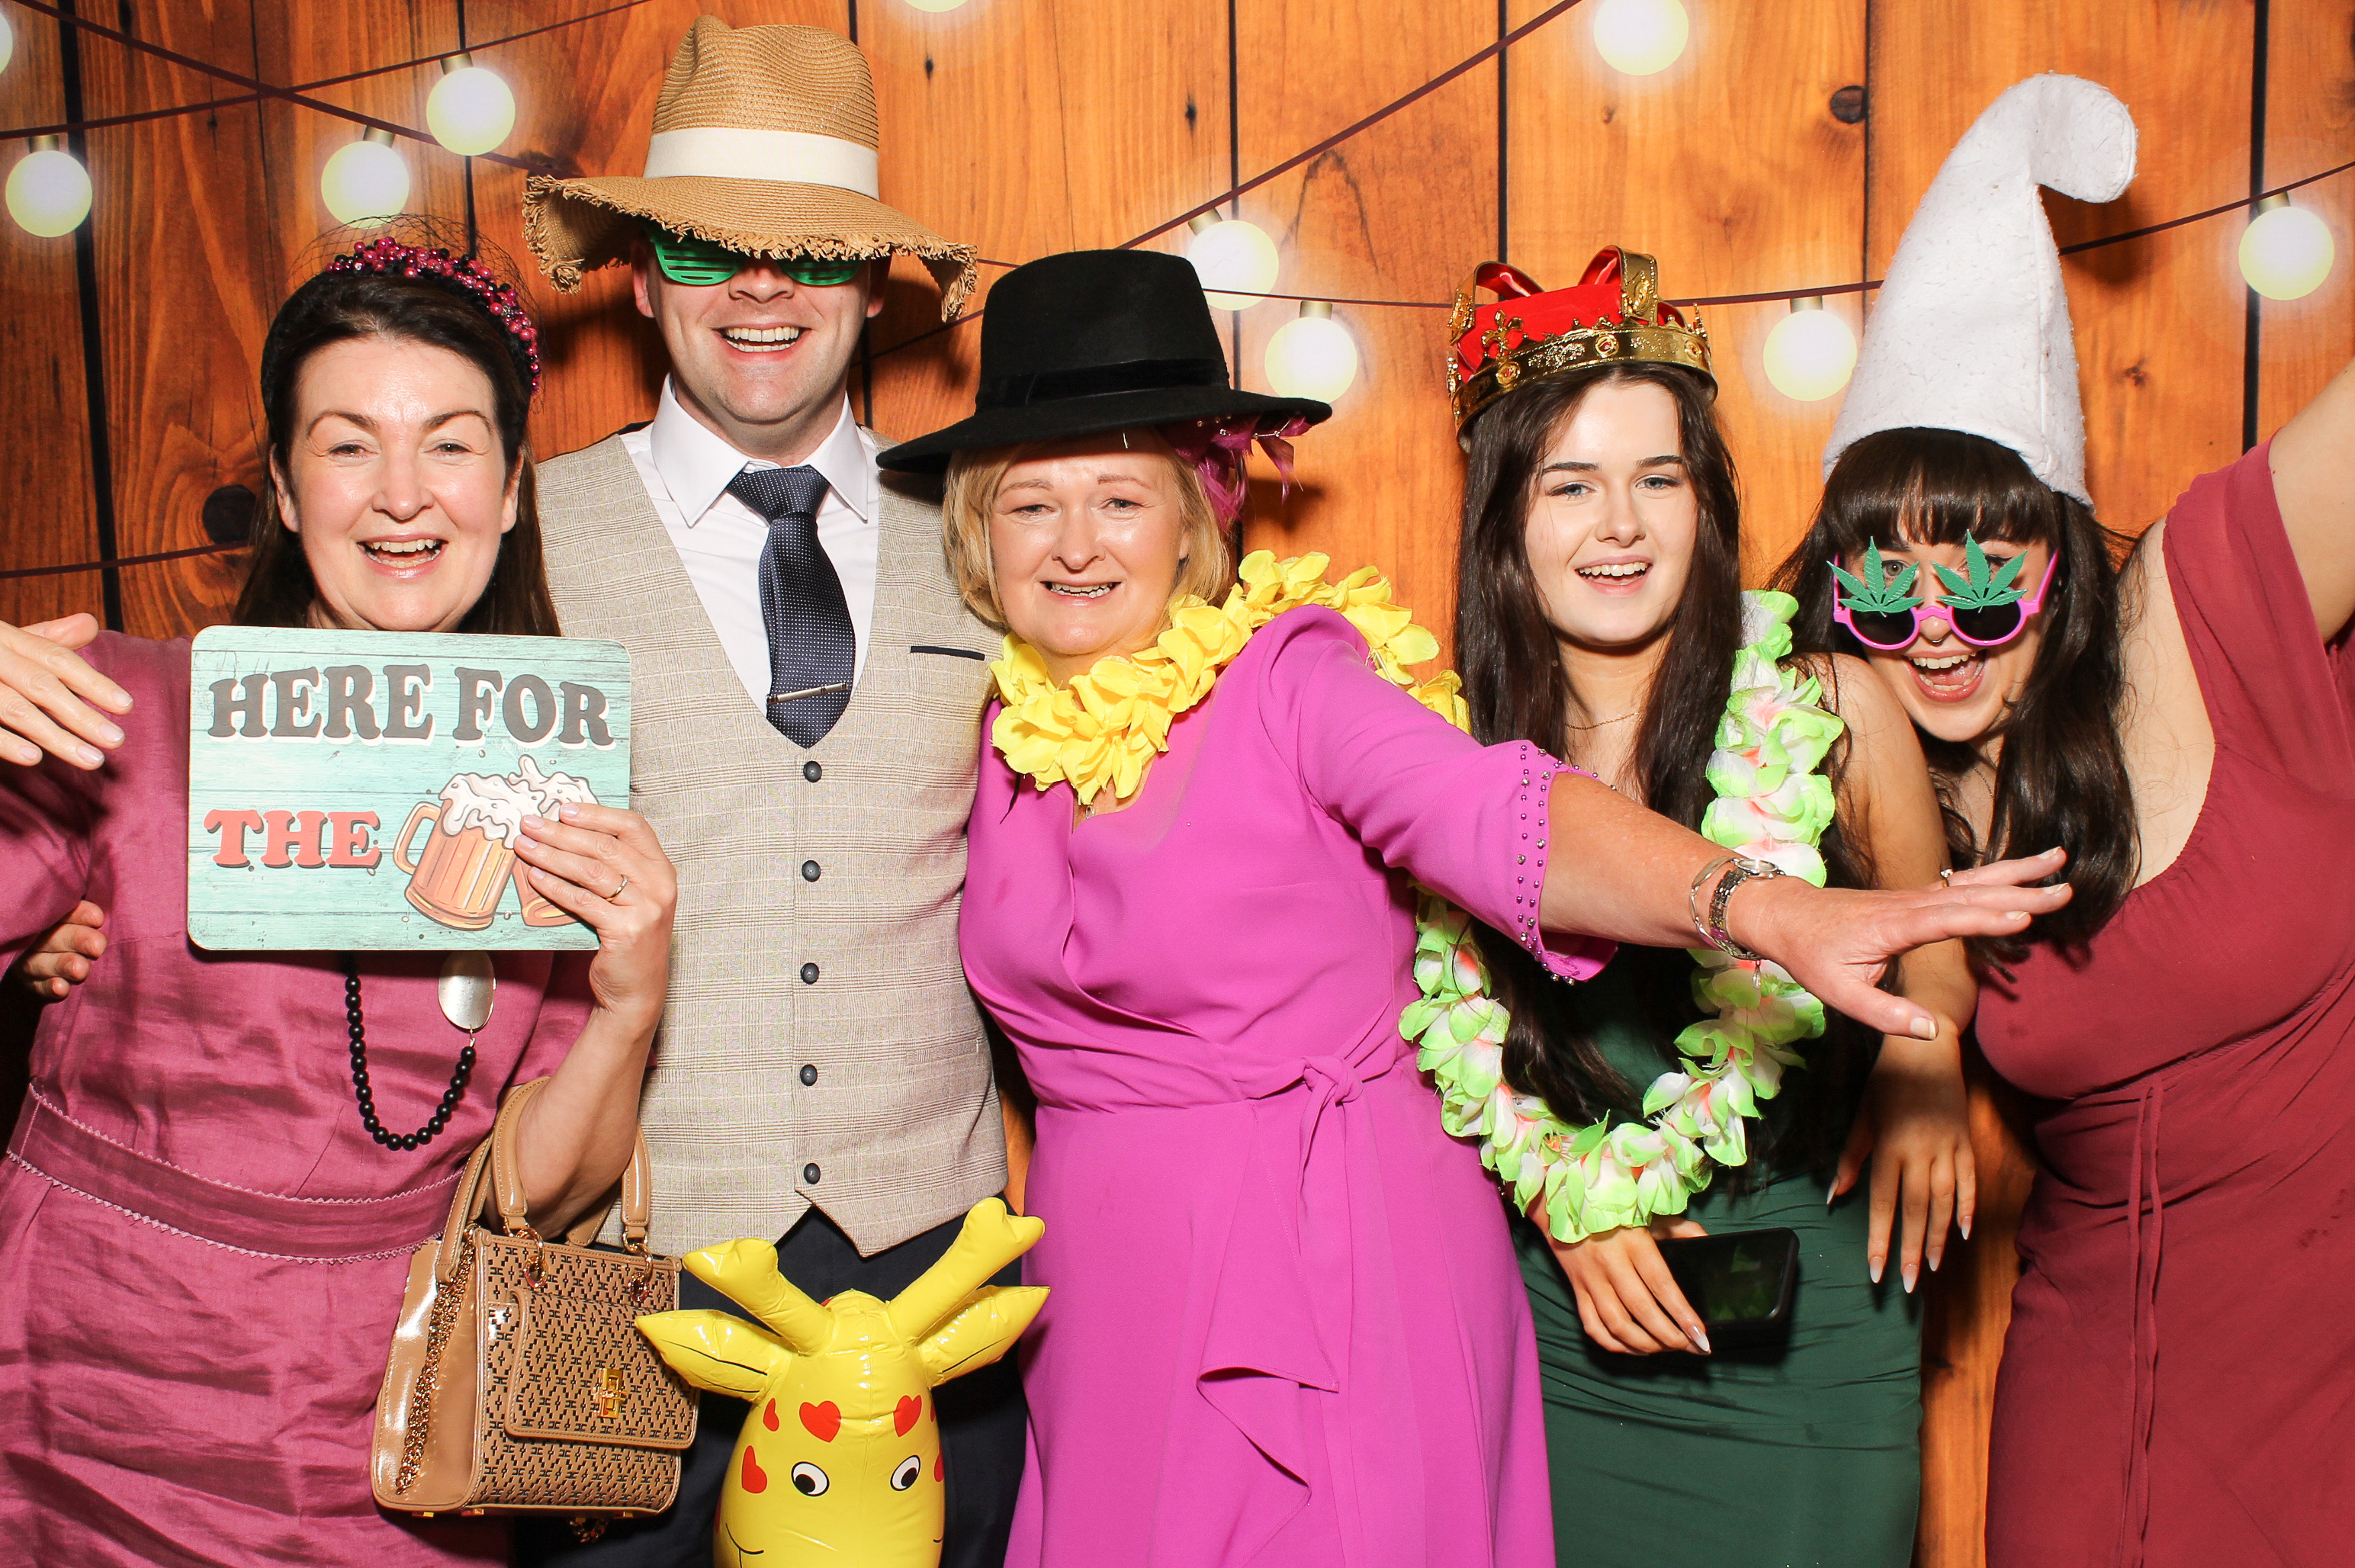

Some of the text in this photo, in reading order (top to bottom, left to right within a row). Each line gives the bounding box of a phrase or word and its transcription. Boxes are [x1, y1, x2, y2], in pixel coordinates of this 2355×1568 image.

[207, 664, 615, 749] HERE FOR
[204, 809, 381, 869] THE
